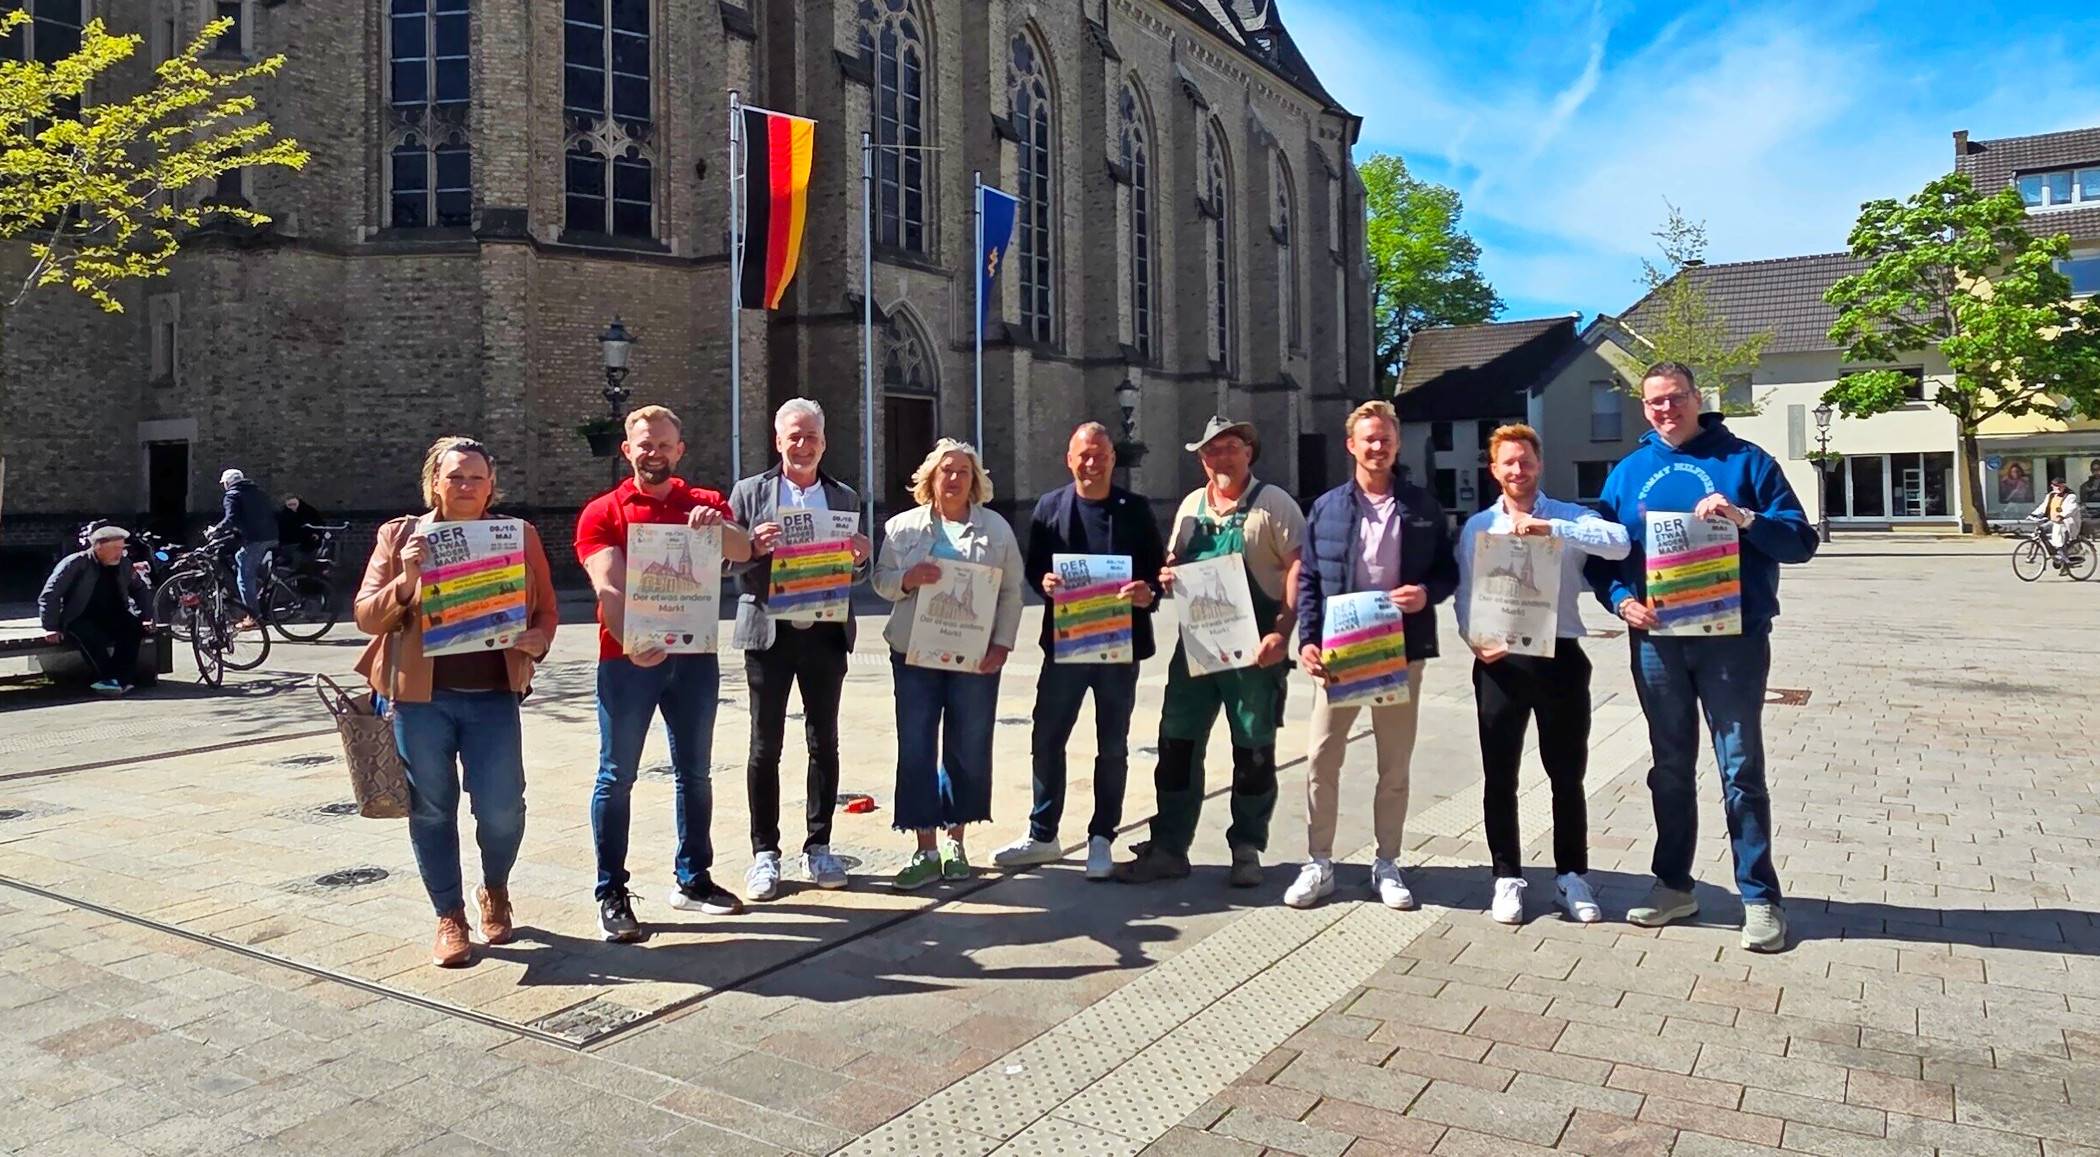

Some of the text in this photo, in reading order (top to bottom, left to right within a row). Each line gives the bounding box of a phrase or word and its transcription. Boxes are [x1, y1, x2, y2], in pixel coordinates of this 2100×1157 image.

[1637, 462, 1715, 500] TOMMY HILFIGER
[783, 513, 813, 527] DER
[1653, 518, 1684, 533] DER
[427, 526, 465, 545] DER
[1060, 559, 1087, 573] DER
[659, 604, 684, 612] Markt
